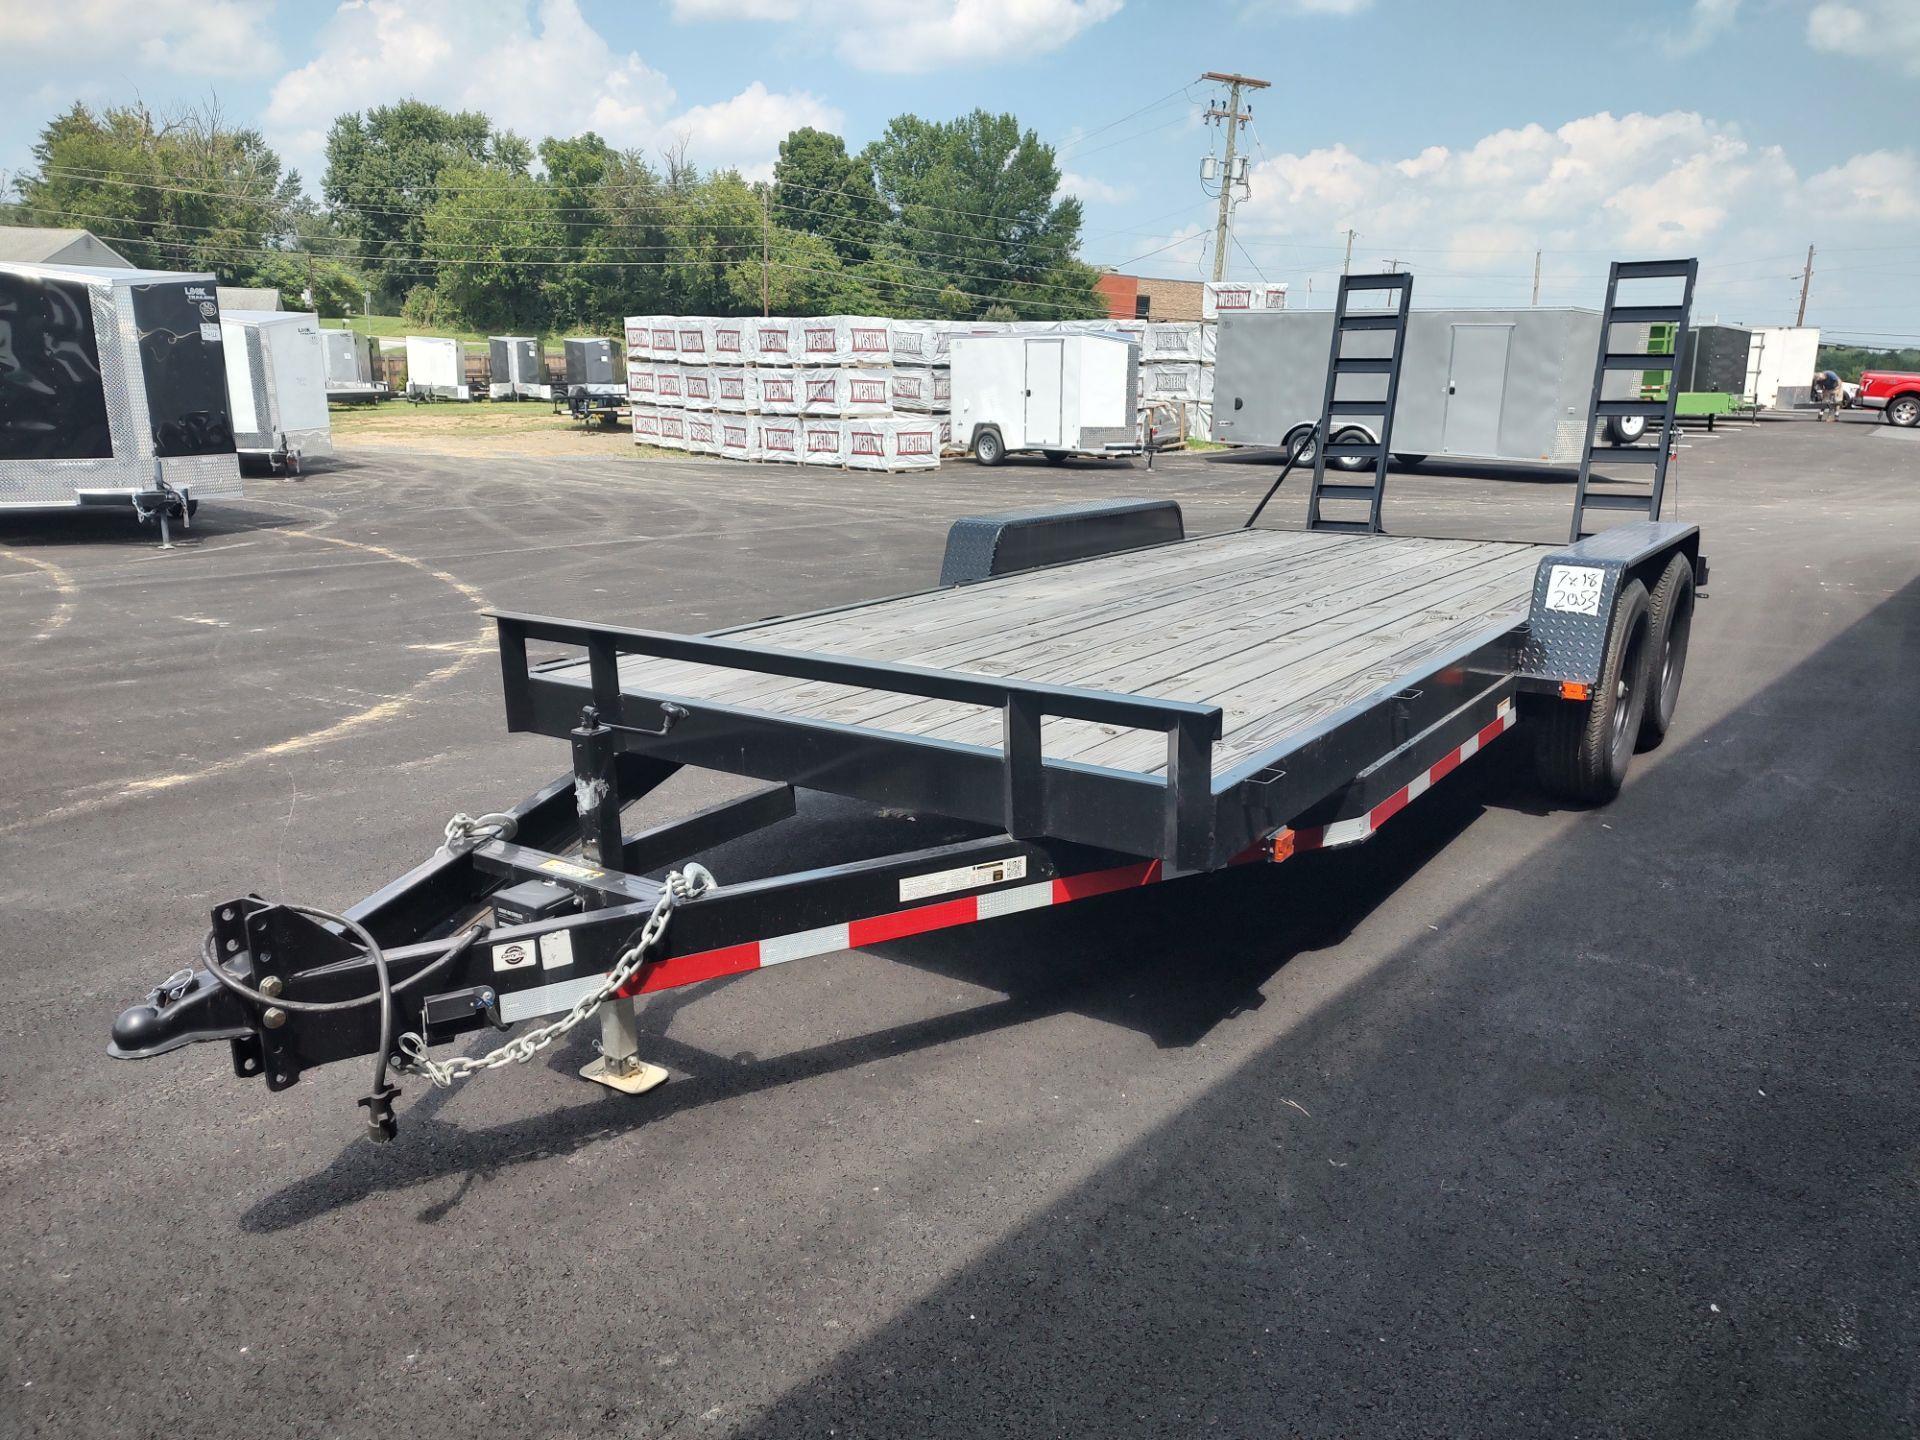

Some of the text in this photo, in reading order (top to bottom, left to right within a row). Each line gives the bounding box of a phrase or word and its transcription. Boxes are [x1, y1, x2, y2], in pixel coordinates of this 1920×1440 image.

[1218, 292, 1248, 306] WESTERN
[853, 331, 886, 350] WESTERN
[852, 382, 884, 401] WESTERN
[898, 434, 931, 452] WESTERN
